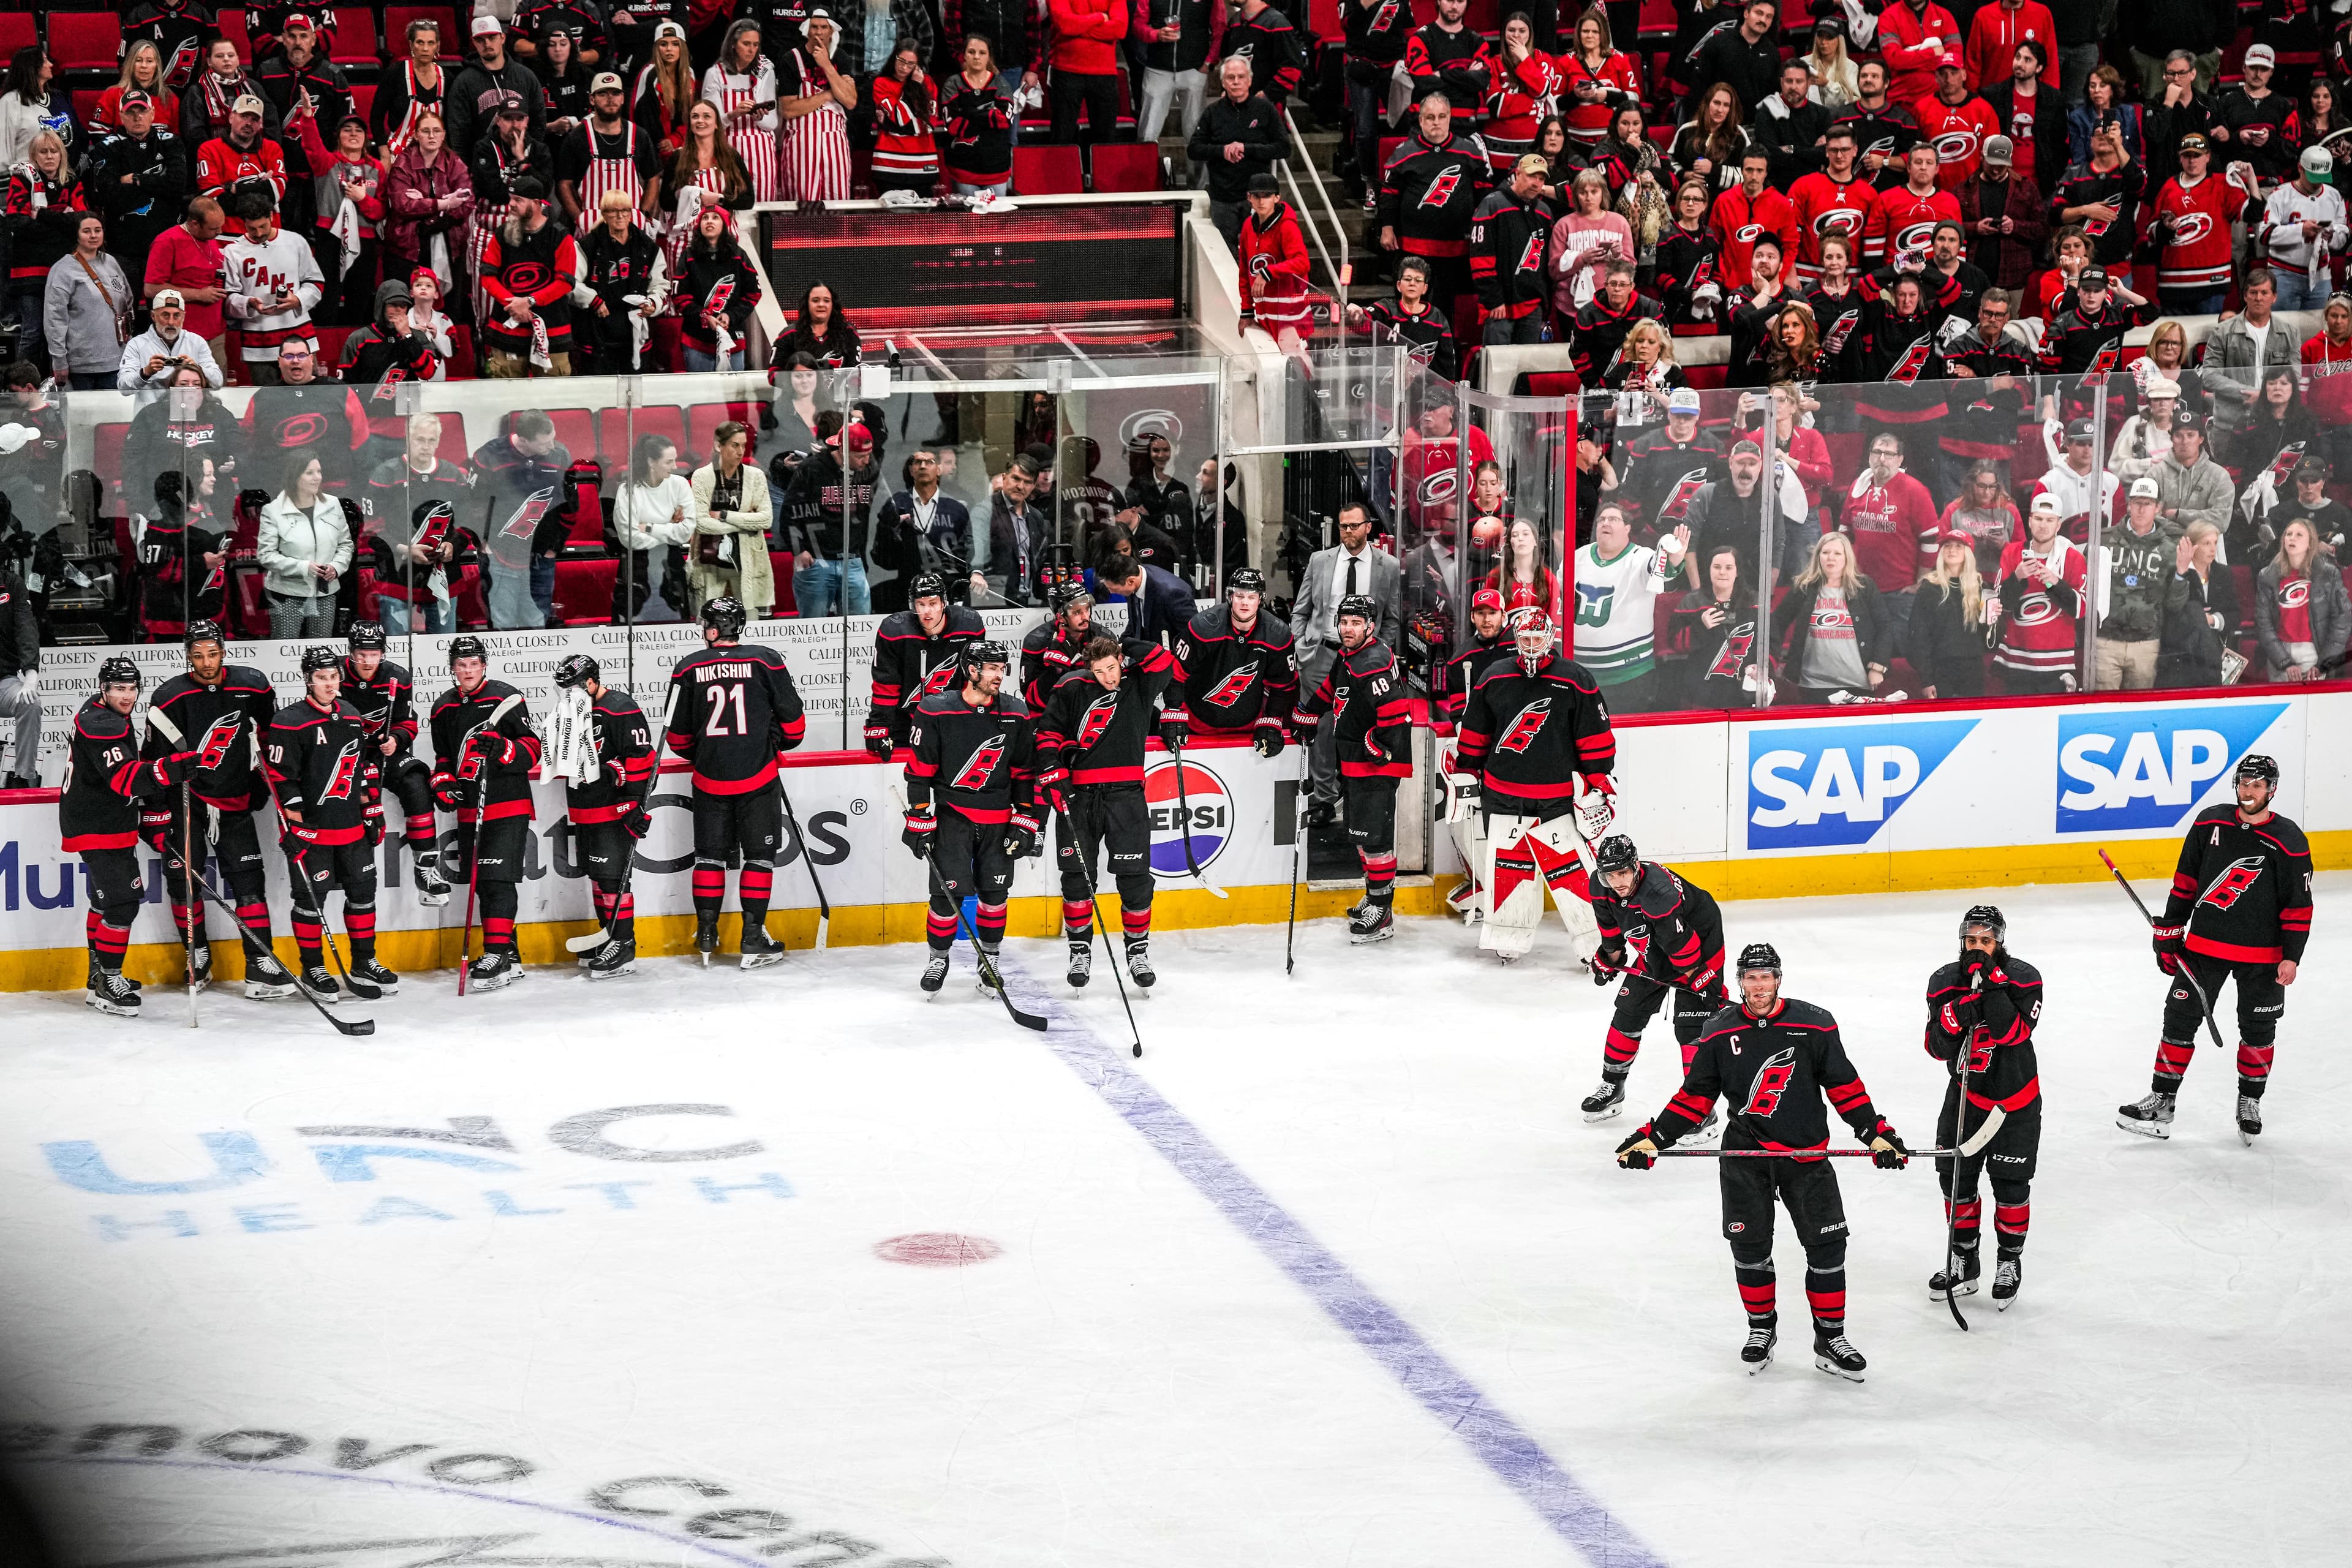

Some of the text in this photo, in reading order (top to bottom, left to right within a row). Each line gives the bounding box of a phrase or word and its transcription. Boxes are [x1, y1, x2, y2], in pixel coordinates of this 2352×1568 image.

[154, 24, 164, 39] A
[1471, 225, 1484, 243] 48
[1387, 322, 1400, 342] A
[361, 497, 373, 516] 53
[146, 545, 161, 564] 37
[591, 631, 665, 644] CALIFORNIA
[744, 624, 818, 638] CALIFORNIA
[516, 635, 568, 648] CLOSETS
[1175, 638, 1190, 661] 50
[41, 651, 96, 665] CLOSETS
[809, 646, 873, 660] CALIFORNI
[695, 663, 752, 683] NIKISHIN
[1371, 677, 1390, 696] 48
[706, 683, 748, 736] 21
[316, 726, 328, 745] A
[561, 717, 571, 761] BODYARMOR
[631, 728, 649, 745] 22
[103, 746, 123, 769] 26
[268, 744, 284, 764] 20
[2059, 729, 2230, 812] SAP
[1751, 745, 1920, 827] SAP
[1150, 805, 1225, 831] EPSI
[2210, 826, 2220, 846] A
[1547, 862, 1581, 878] TRUE
[1675, 918, 1684, 934] 4
[2253, 1003, 2283, 1013] BAUER
[1730, 1035, 1741, 1055] C
[40, 1103, 766, 1196] UNC
[1992, 1152, 2028, 1165] CCM
[91, 1172, 800, 1242] HEALTH
